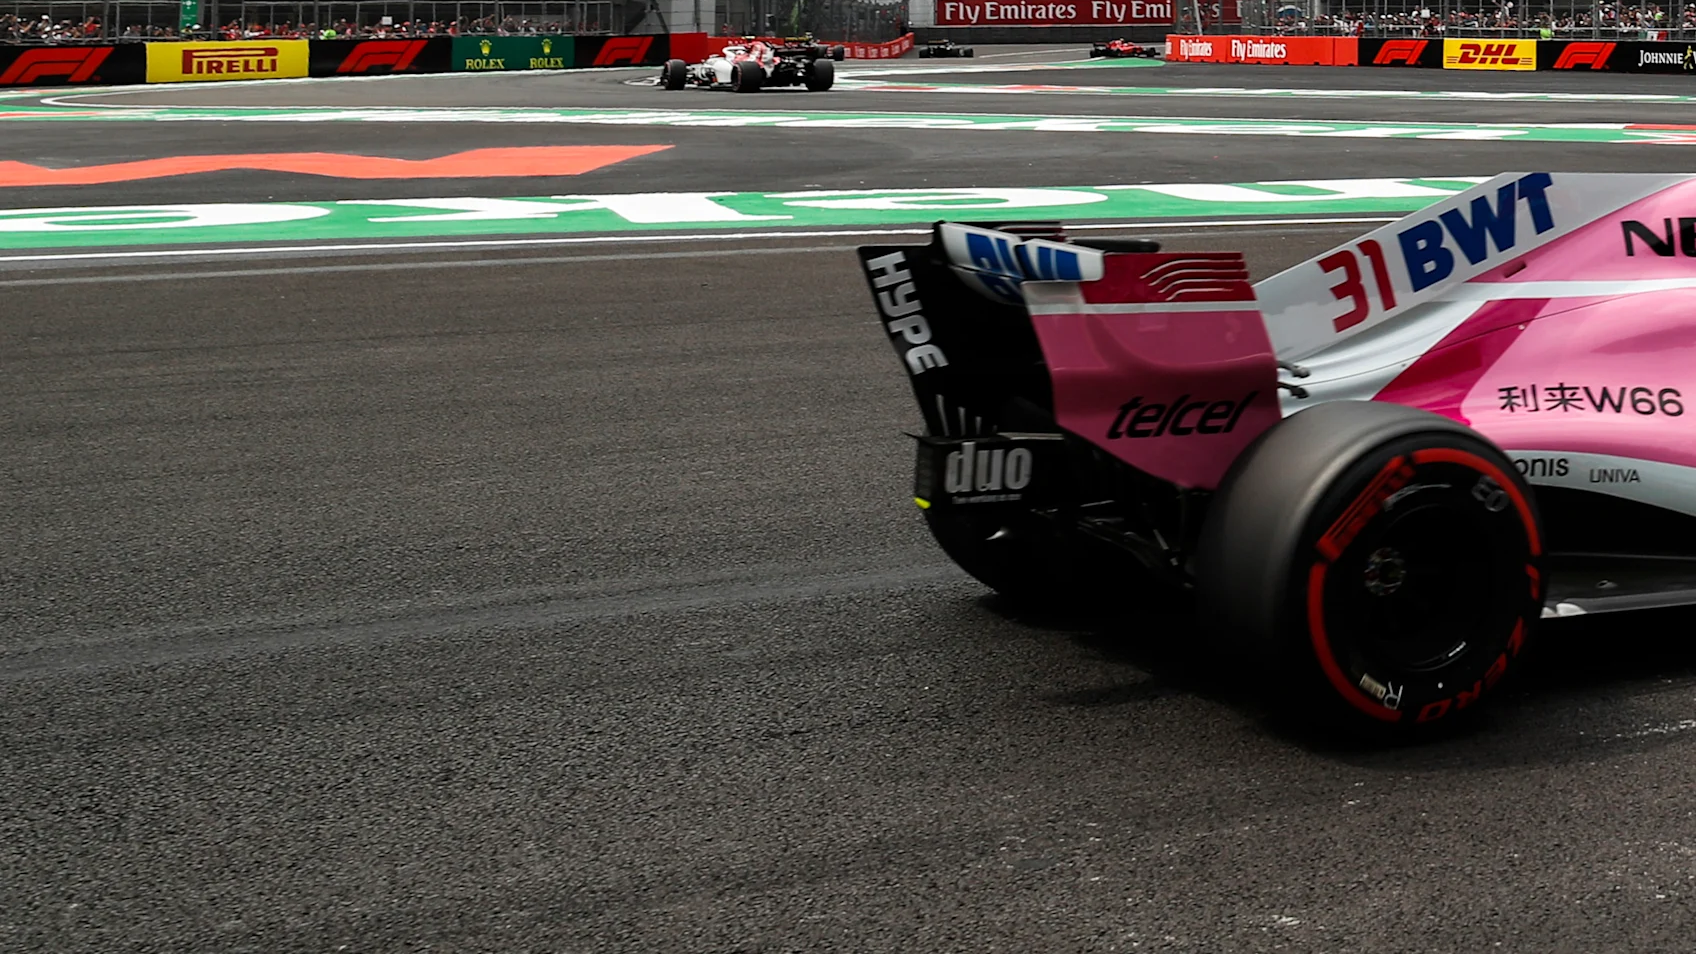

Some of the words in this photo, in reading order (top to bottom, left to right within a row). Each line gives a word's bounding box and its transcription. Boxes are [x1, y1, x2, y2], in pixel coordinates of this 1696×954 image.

[945, 1, 981, 23] Fly
[986, 1, 1077, 19] Emirates
[1091, 1, 1127, 22] Fly
[182, 47, 278, 74] PIRELLI
[1231, 39, 1248, 61] Fly
[1247, 40, 1287, 59] Emirates
[1458, 43, 1521, 65] DHL
[1638, 49, 1684, 67] JOHNNIE
[465, 58, 505, 69] ROLEX
[530, 57, 564, 69] ROLEX
[1317, 239, 1398, 333] 31
[1398, 172, 1555, 293] BWT
[866, 251, 950, 375] HYPE
[1106, 391, 1261, 441] telcel
[945, 441, 1033, 494] duo
[1515, 456, 1570, 478] onis
[1590, 467, 1641, 484] UNIVA
